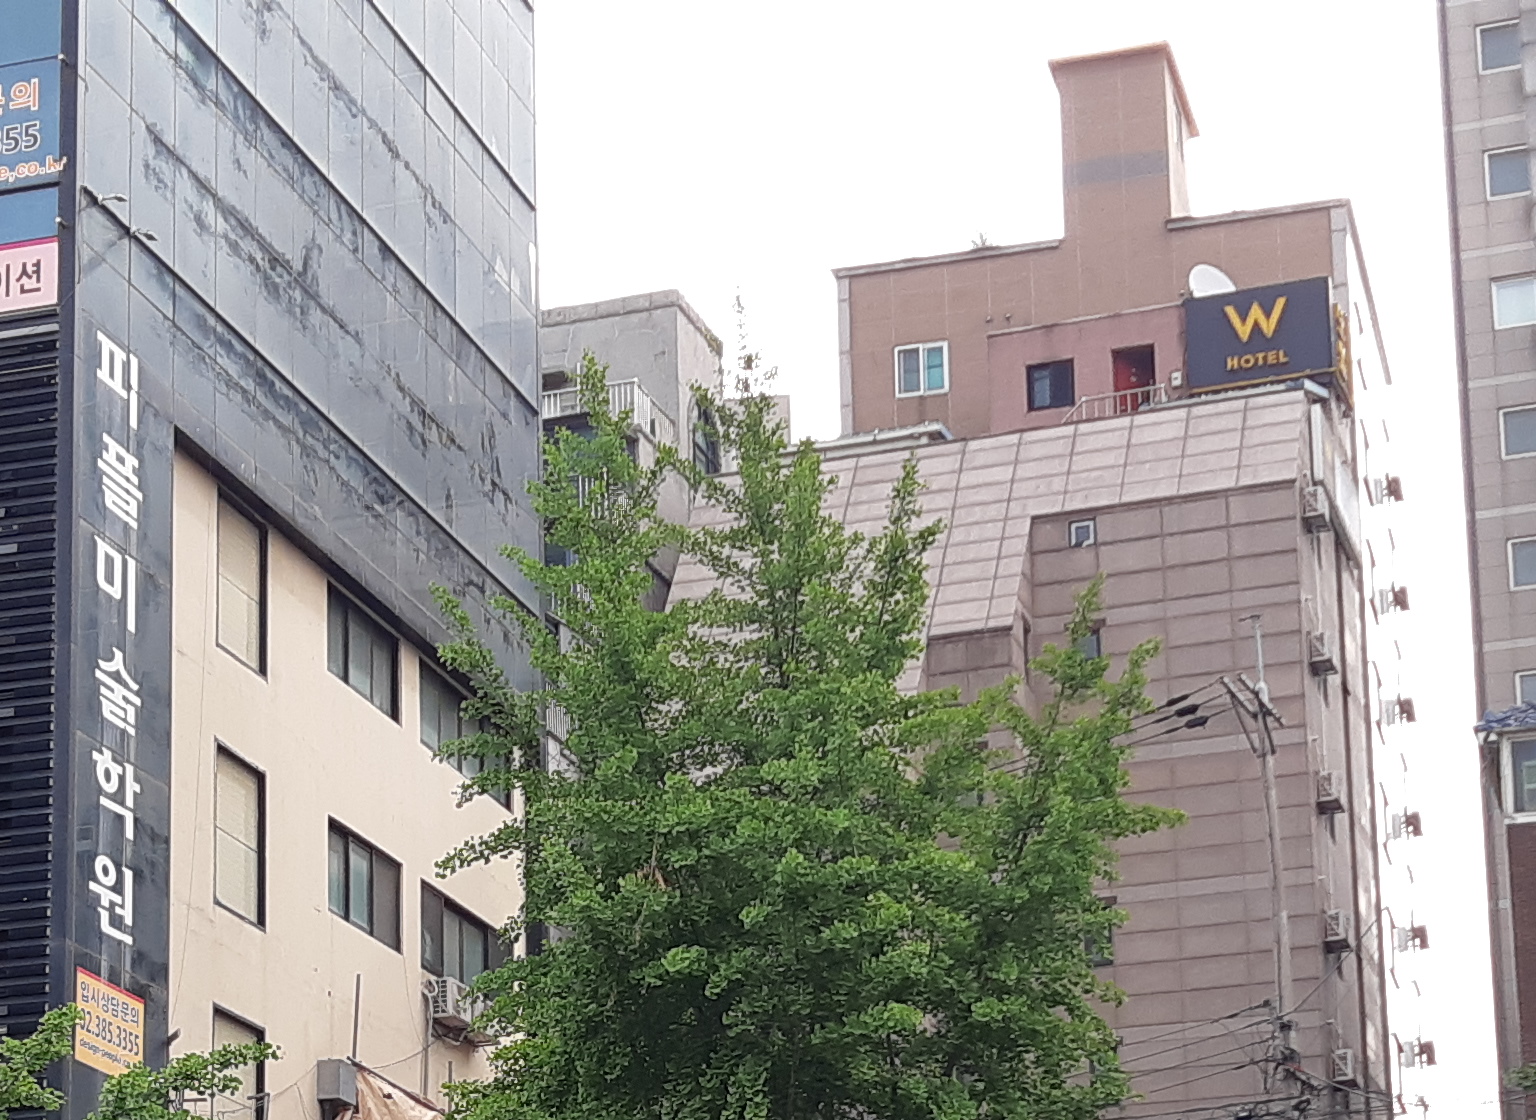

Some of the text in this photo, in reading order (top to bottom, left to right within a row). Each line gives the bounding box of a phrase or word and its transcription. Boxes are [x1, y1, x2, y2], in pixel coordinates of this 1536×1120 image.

[1223, 296, 1288, 343] W
[1225, 349, 1290, 372] HOTEL
[88, 329, 144, 947] 피플미술학원
[80, 980, 140, 1028] 입시상담문의
